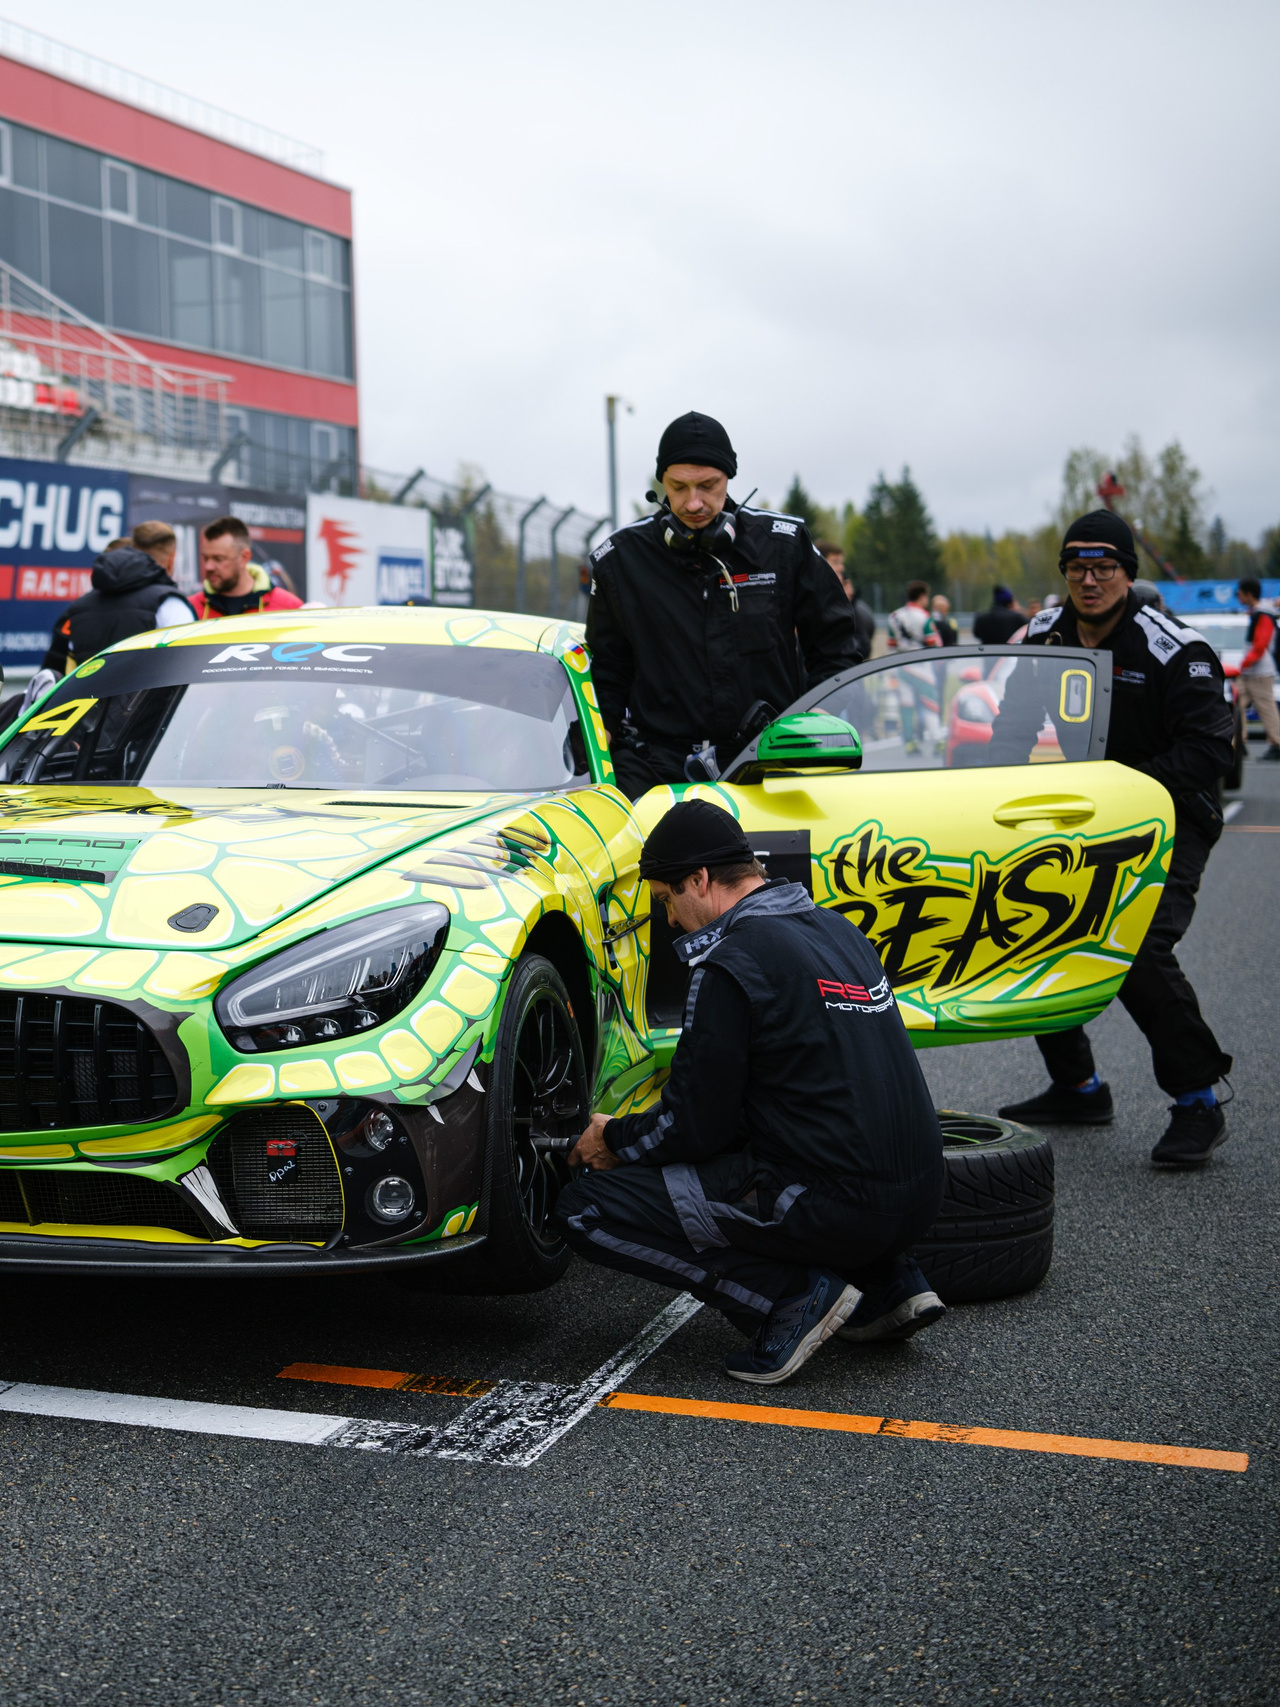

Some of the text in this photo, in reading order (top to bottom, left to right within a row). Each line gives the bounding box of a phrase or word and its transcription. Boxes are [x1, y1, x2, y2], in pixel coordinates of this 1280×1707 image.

[1188, 662, 1213, 678] OMP
[18, 698, 99, 736] 4
[829, 828, 927, 898] the
[685, 927, 722, 955] HRX
